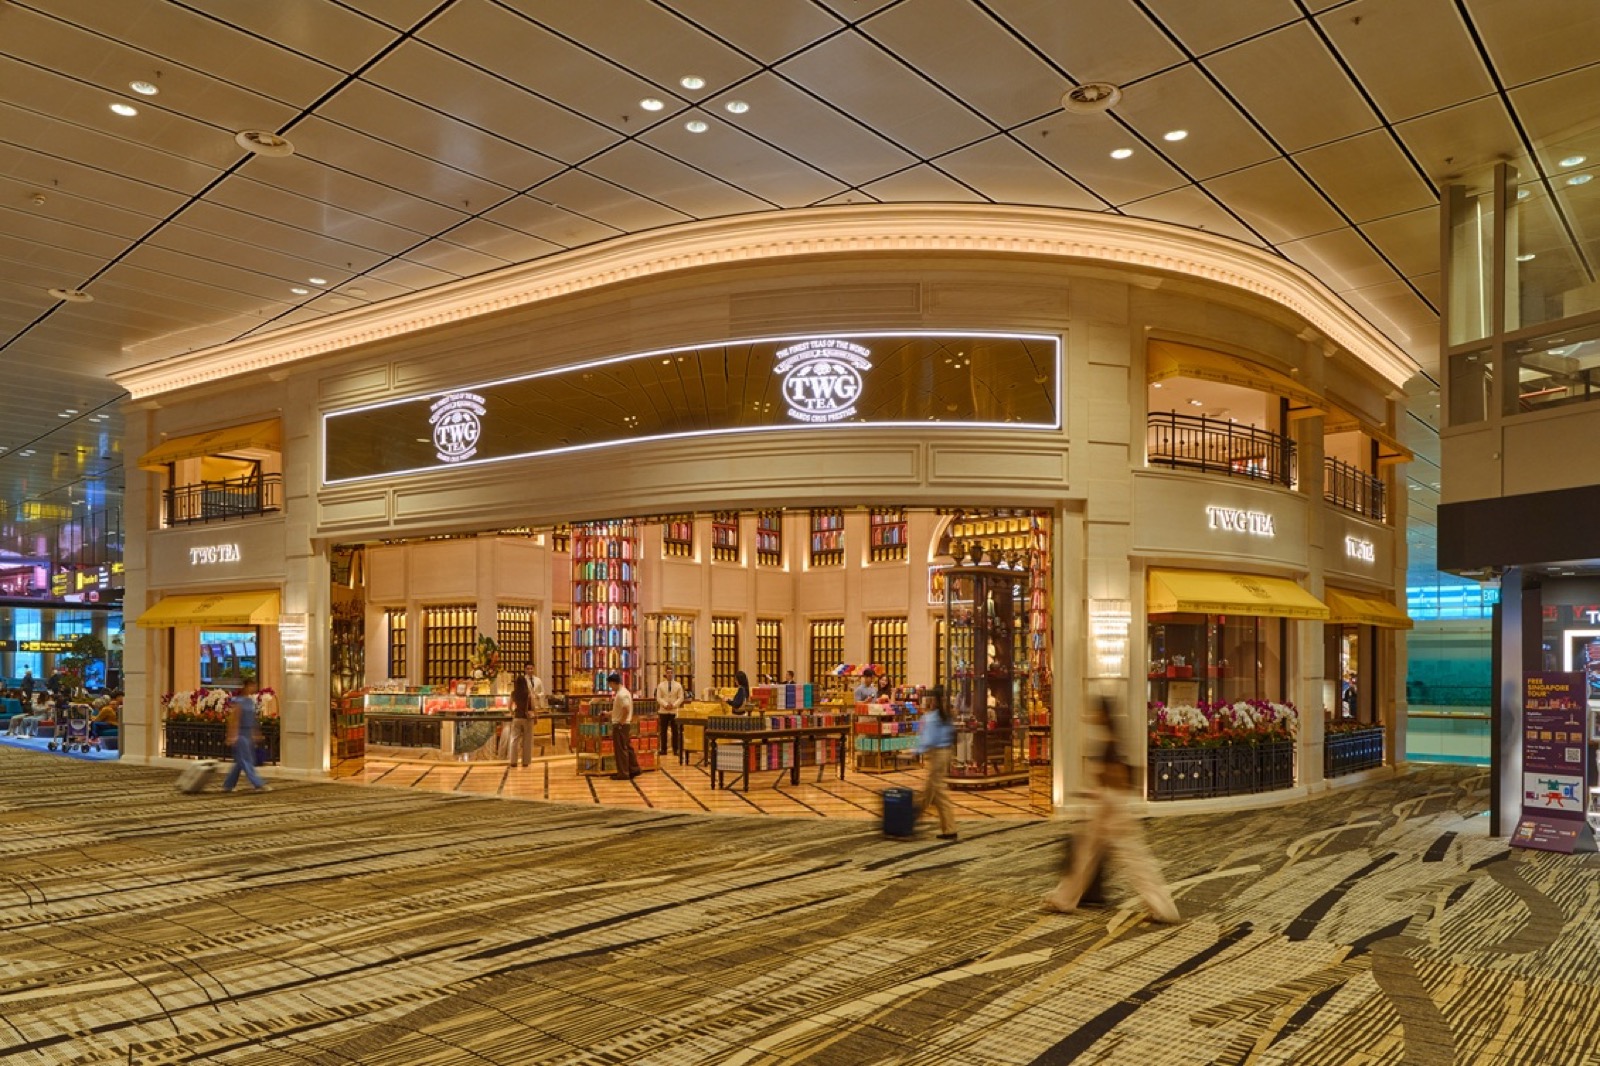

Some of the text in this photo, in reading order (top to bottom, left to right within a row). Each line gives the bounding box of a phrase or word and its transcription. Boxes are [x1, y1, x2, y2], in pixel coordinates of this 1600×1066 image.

[788, 375, 857, 400] TWG
[804, 398, 837, 409] TEA
[437, 421, 477, 445] TWG
[446, 442, 466, 452] TEA
[1205, 505, 1276, 536] TWG TEA
[189, 543, 241, 565] TWG TEA
[1527, 677, 1543, 685] FREE
[1527, 684, 1569, 692] SINGAPORE
[1527, 690, 1547, 698] TOUR
